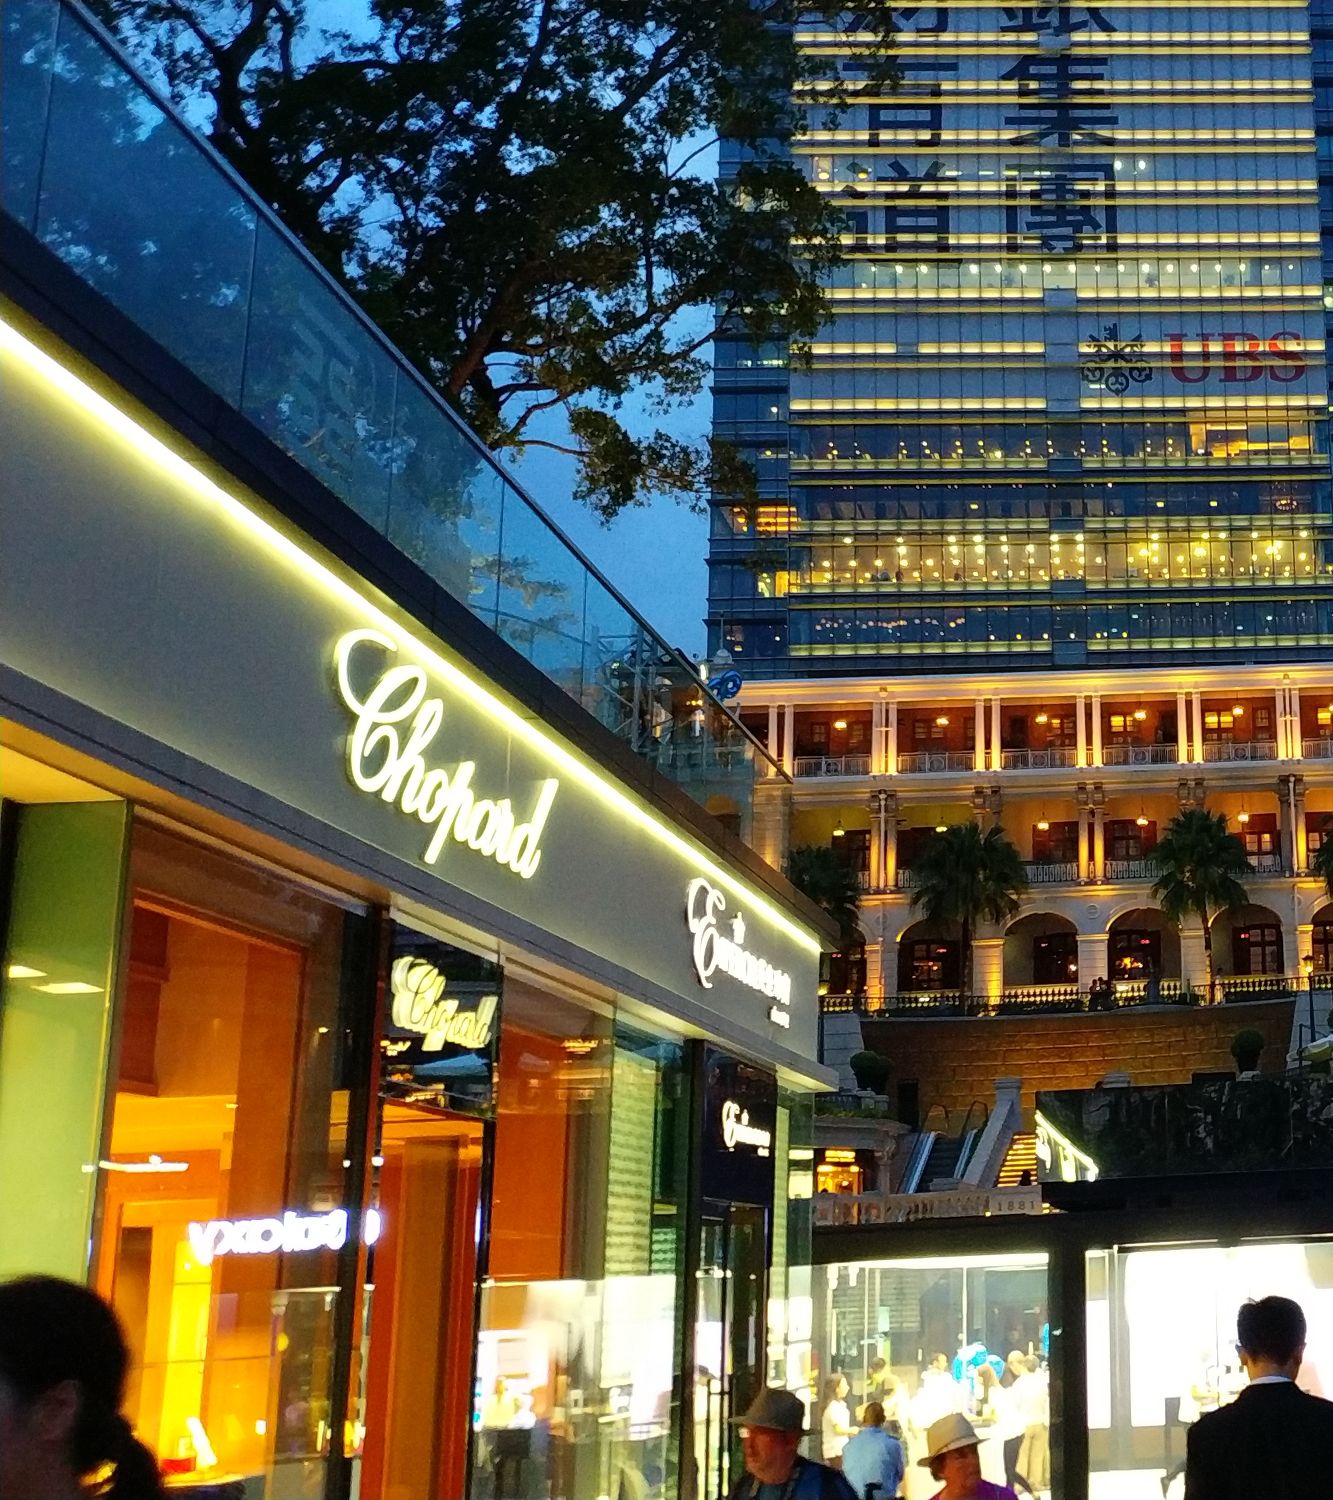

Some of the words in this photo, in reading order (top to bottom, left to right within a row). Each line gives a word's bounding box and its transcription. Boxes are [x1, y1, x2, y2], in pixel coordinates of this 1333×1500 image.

[842, 0, 963, 264] 有道
[1164, 331, 1307, 384] UBS
[334, 628, 559, 879] Chopard
[997, 1200, 1035, 1211] 1881
